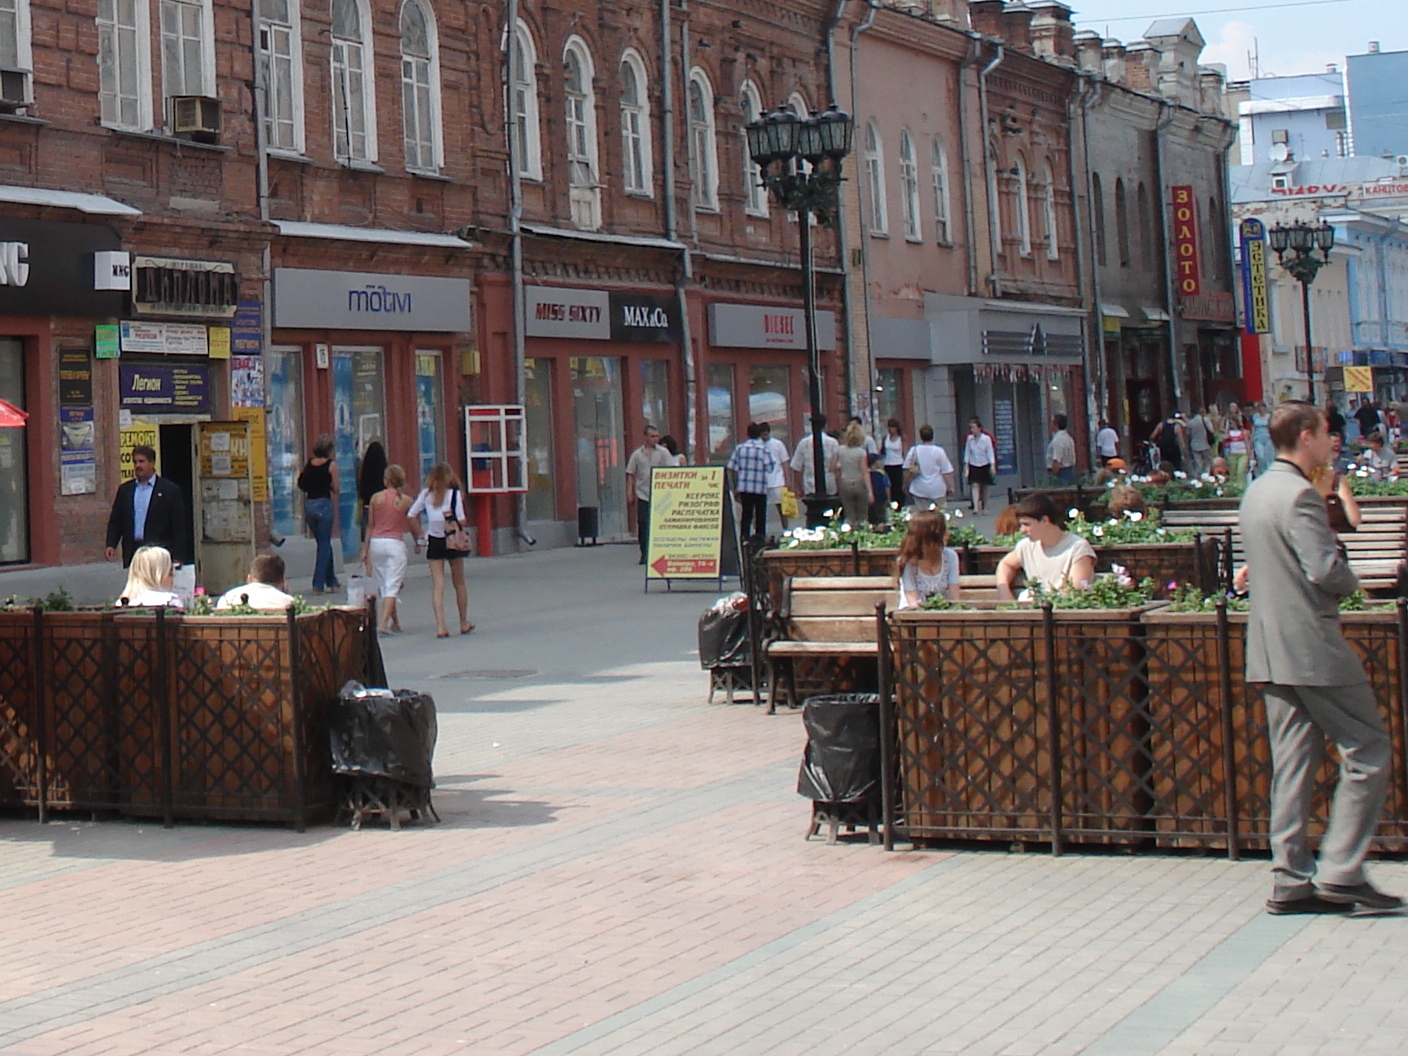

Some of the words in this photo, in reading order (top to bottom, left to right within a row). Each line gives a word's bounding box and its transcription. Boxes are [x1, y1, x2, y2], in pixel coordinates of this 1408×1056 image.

[1176, 190, 1196, 292] ЗОЛОТО
[1251, 241, 1267, 330] ЭСТЕТИКА
[535, 303, 566, 321] MISS
[568, 305, 602, 323] SIXTY
[654, 471, 698, 479] ВИЗИТКИ
